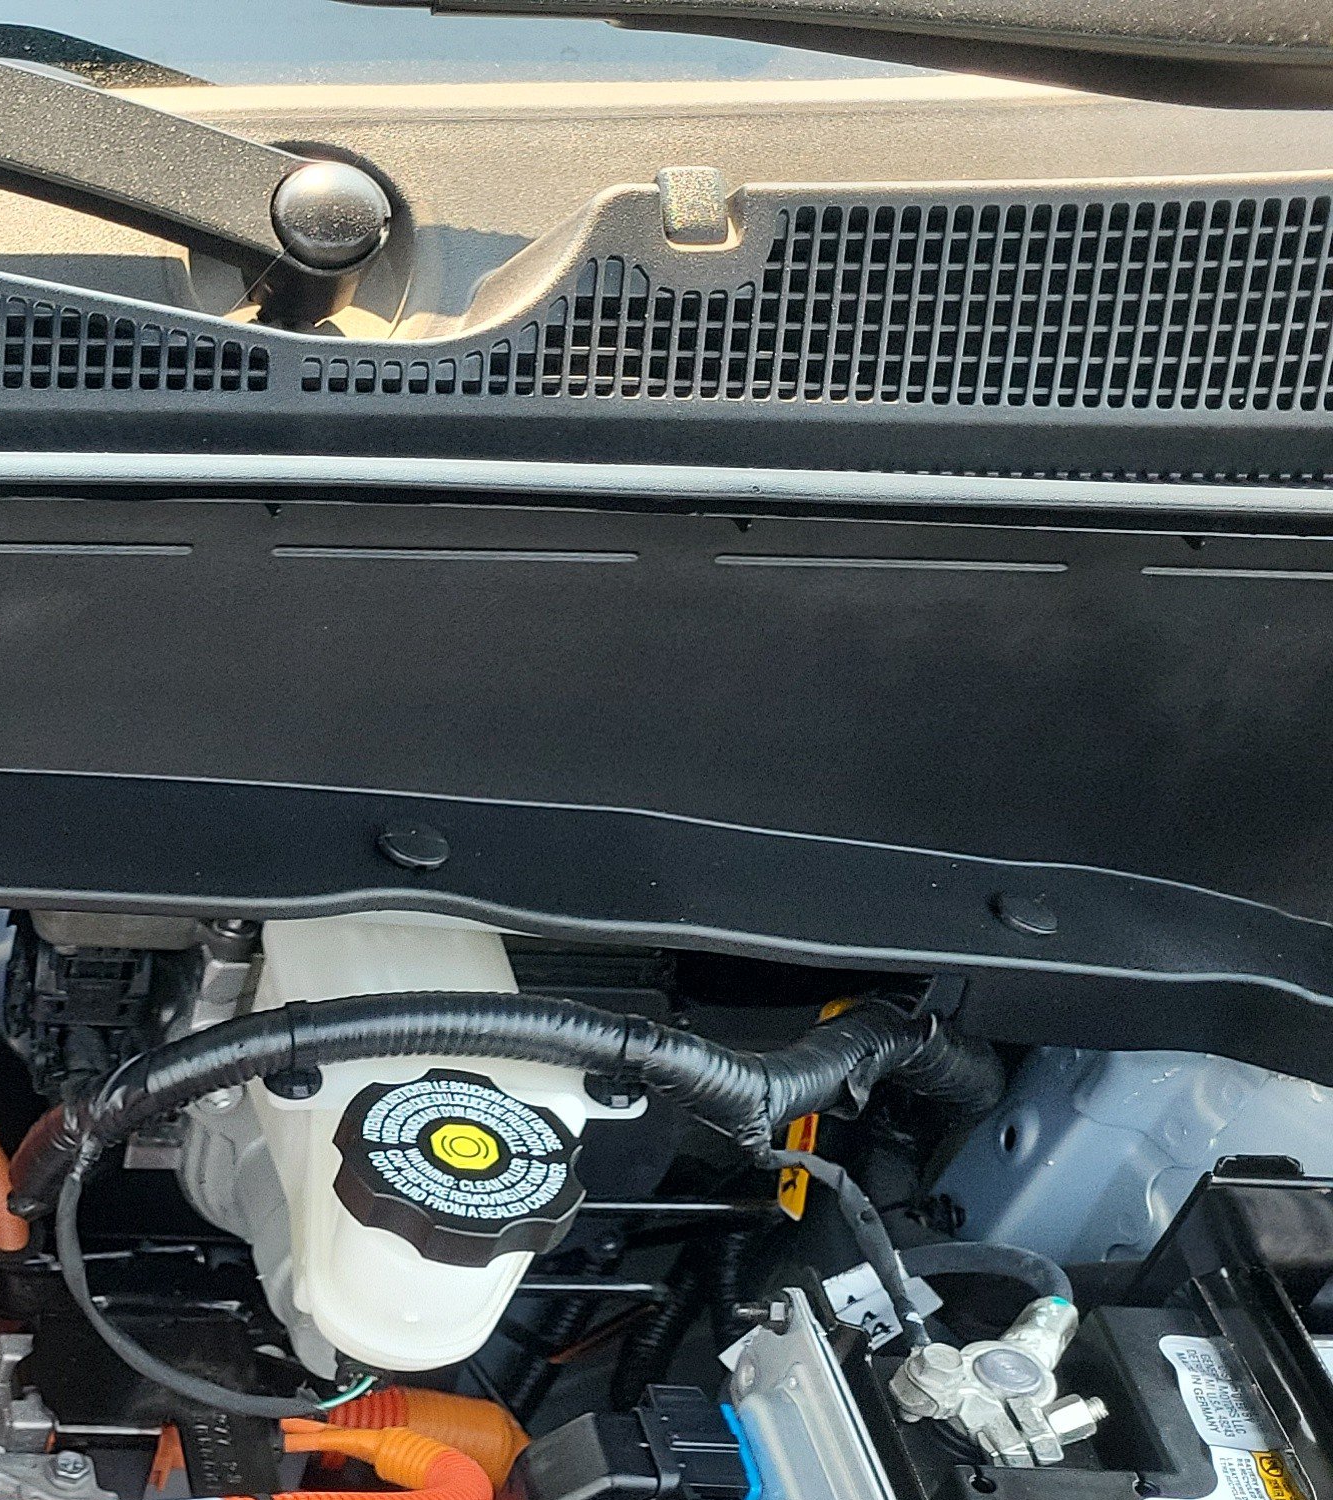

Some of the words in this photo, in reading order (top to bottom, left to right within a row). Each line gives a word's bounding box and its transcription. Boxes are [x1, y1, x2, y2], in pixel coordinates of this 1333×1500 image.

[386, 1151, 409, 1169] CAP
[403, 1149, 457, 1187] WARNING:
[459, 1176, 504, 1191] CLEAN
[496, 1158, 530, 1185] FILLER
[523, 1161, 549, 1184] ONLY
[368, 1152, 393, 1171] DOT
[387, 1175, 428, 1201] FLUID
[423, 1196, 465, 1214] FROM
[478, 1200, 529, 1219] SEALED
[397, 1168, 449, 1198] BEFORE
[1191, 1374, 1202, 1385] IN
[1193, 1387, 1221, 1433] GERMANY
